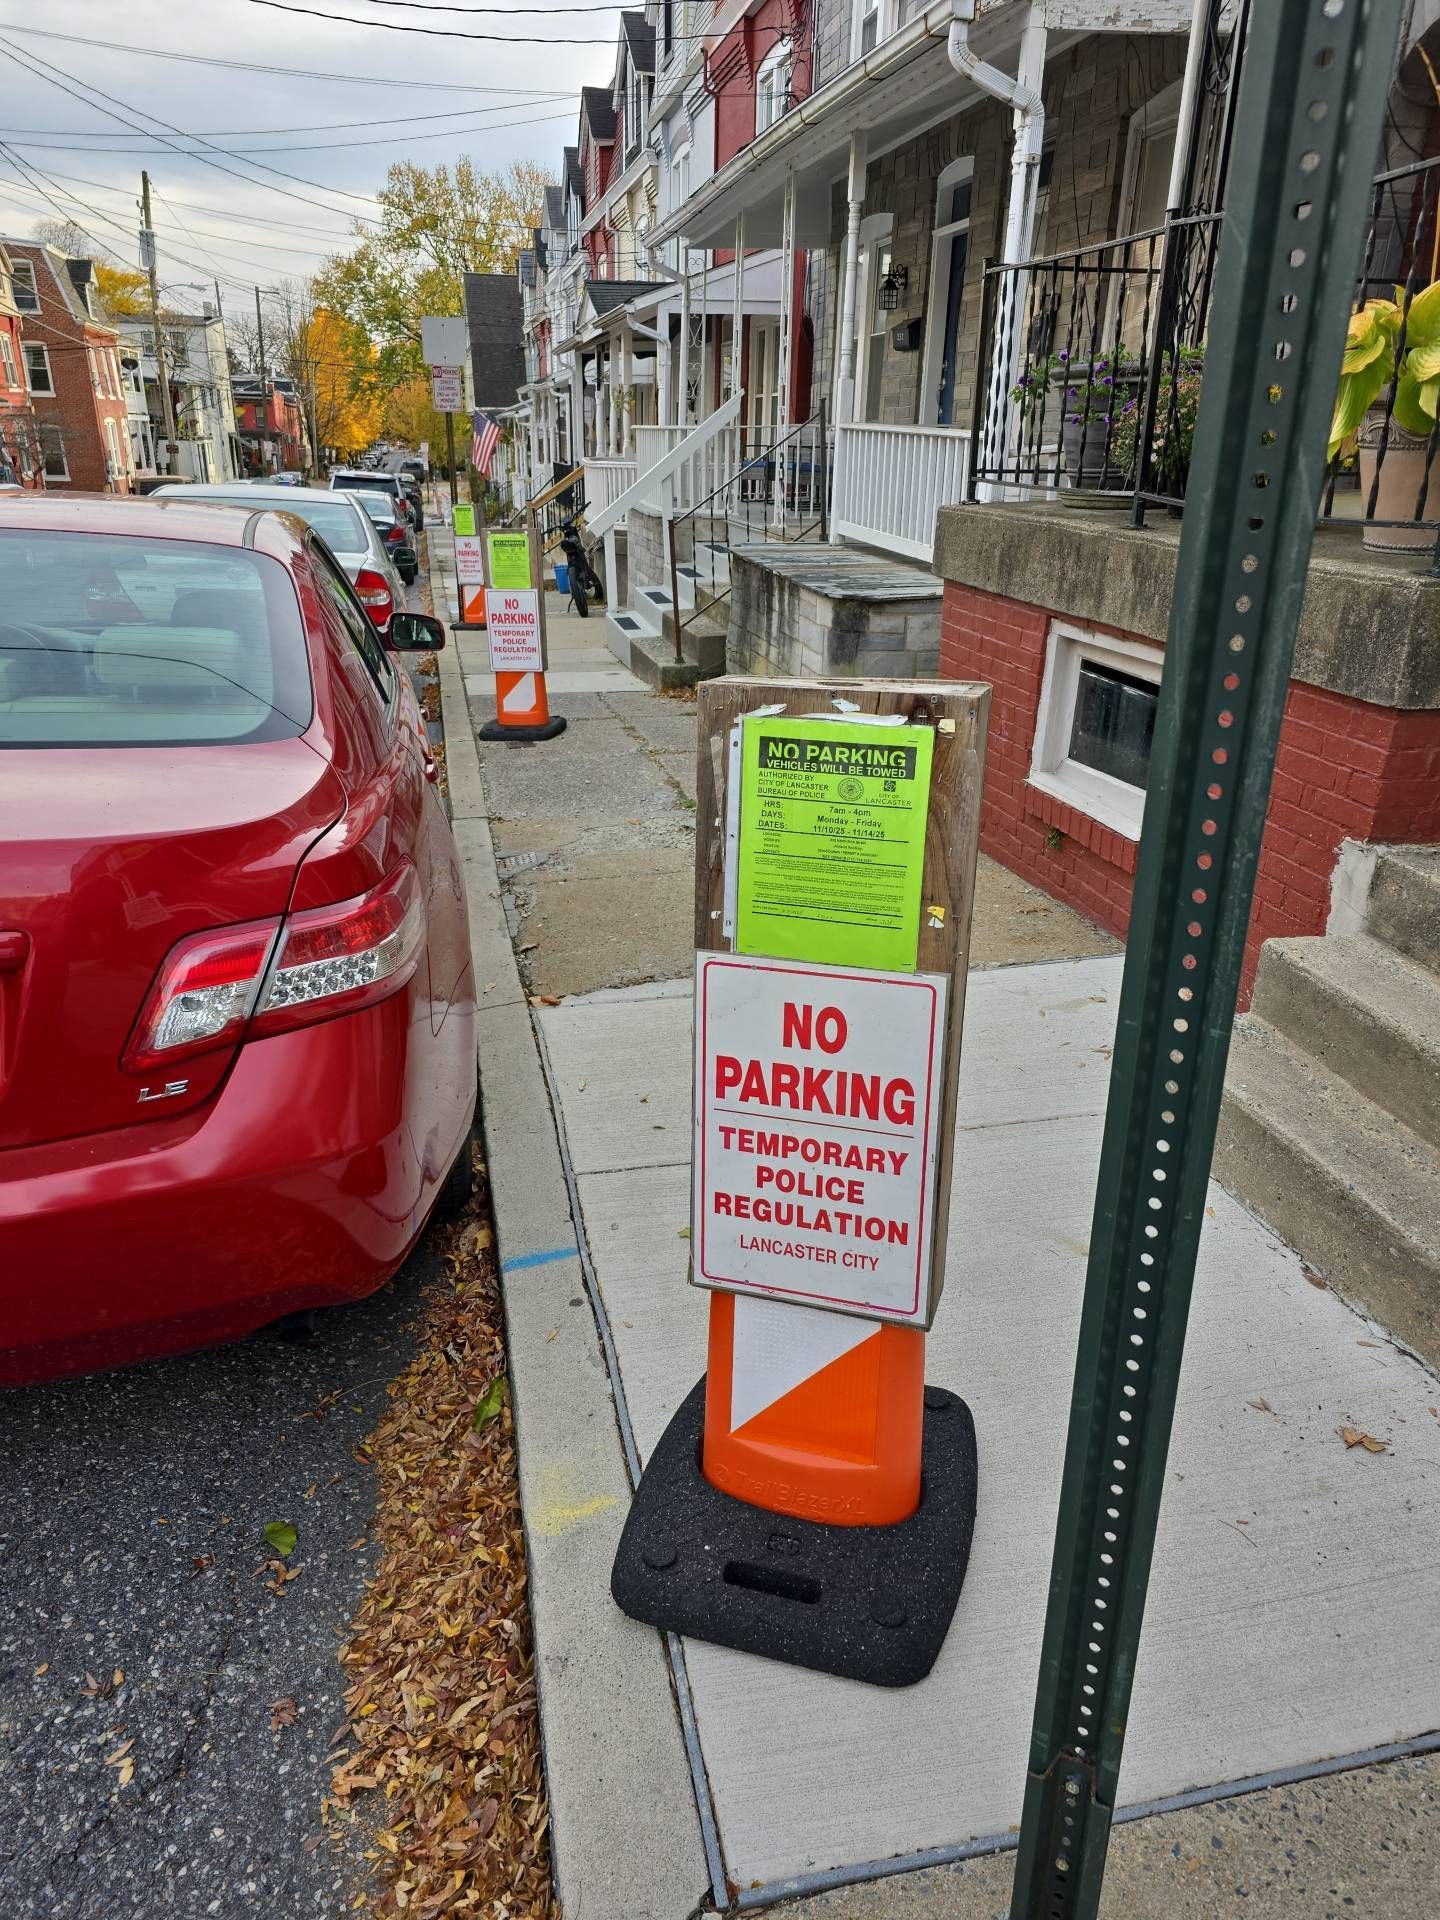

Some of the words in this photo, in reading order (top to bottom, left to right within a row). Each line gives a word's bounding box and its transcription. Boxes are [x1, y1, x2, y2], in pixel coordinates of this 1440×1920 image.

[504, 599, 519, 610] NO
[491, 613, 535, 625] PARKING
[768, 742, 800, 759] NO
[806, 744, 906, 767] PARKING
[758, 771, 803, 780] AUTHORIZED
[804, 774, 815, 782] BY
[767, 759, 818, 772] VEHICLES
[820, 763, 846, 774] WILL
[848, 765, 864, 775] BE
[866, 766, 906, 778] TOWED
[757, 787, 787, 795] BUREAU
[799, 790, 825, 799] POLICE
[758, 778, 774, 786] CITY
[786, 781, 829, 791] LANCASTER
[764, 799, 784, 809] HRS:
[829, 806, 846, 814] 7am
[853, 808, 871, 816] 4pm
[865, 798, 912, 806] LANCASTER
[758, 819, 788, 830] DATES:
[813, 825, 845, 835] 11/10/25
[852, 829, 885, 838] 11/14/25
[761, 810, 785, 819] DAYS:
[817, 815, 849, 825] Monday
[856, 818, 882, 828] Friday
[782, 1002, 848, 1055] NO
[136, 1079, 189, 1103] LE
[715, 1055, 915, 1126] PARKING
[718, 1125, 909, 1176] TEMPORARY
[756, 1165, 865, 1205] POLICE
[714, 1192, 909, 1246] REGULATION
[739, 1234, 837, 1265] LANCASTER
[842, 1251, 880, 1272] CITY
